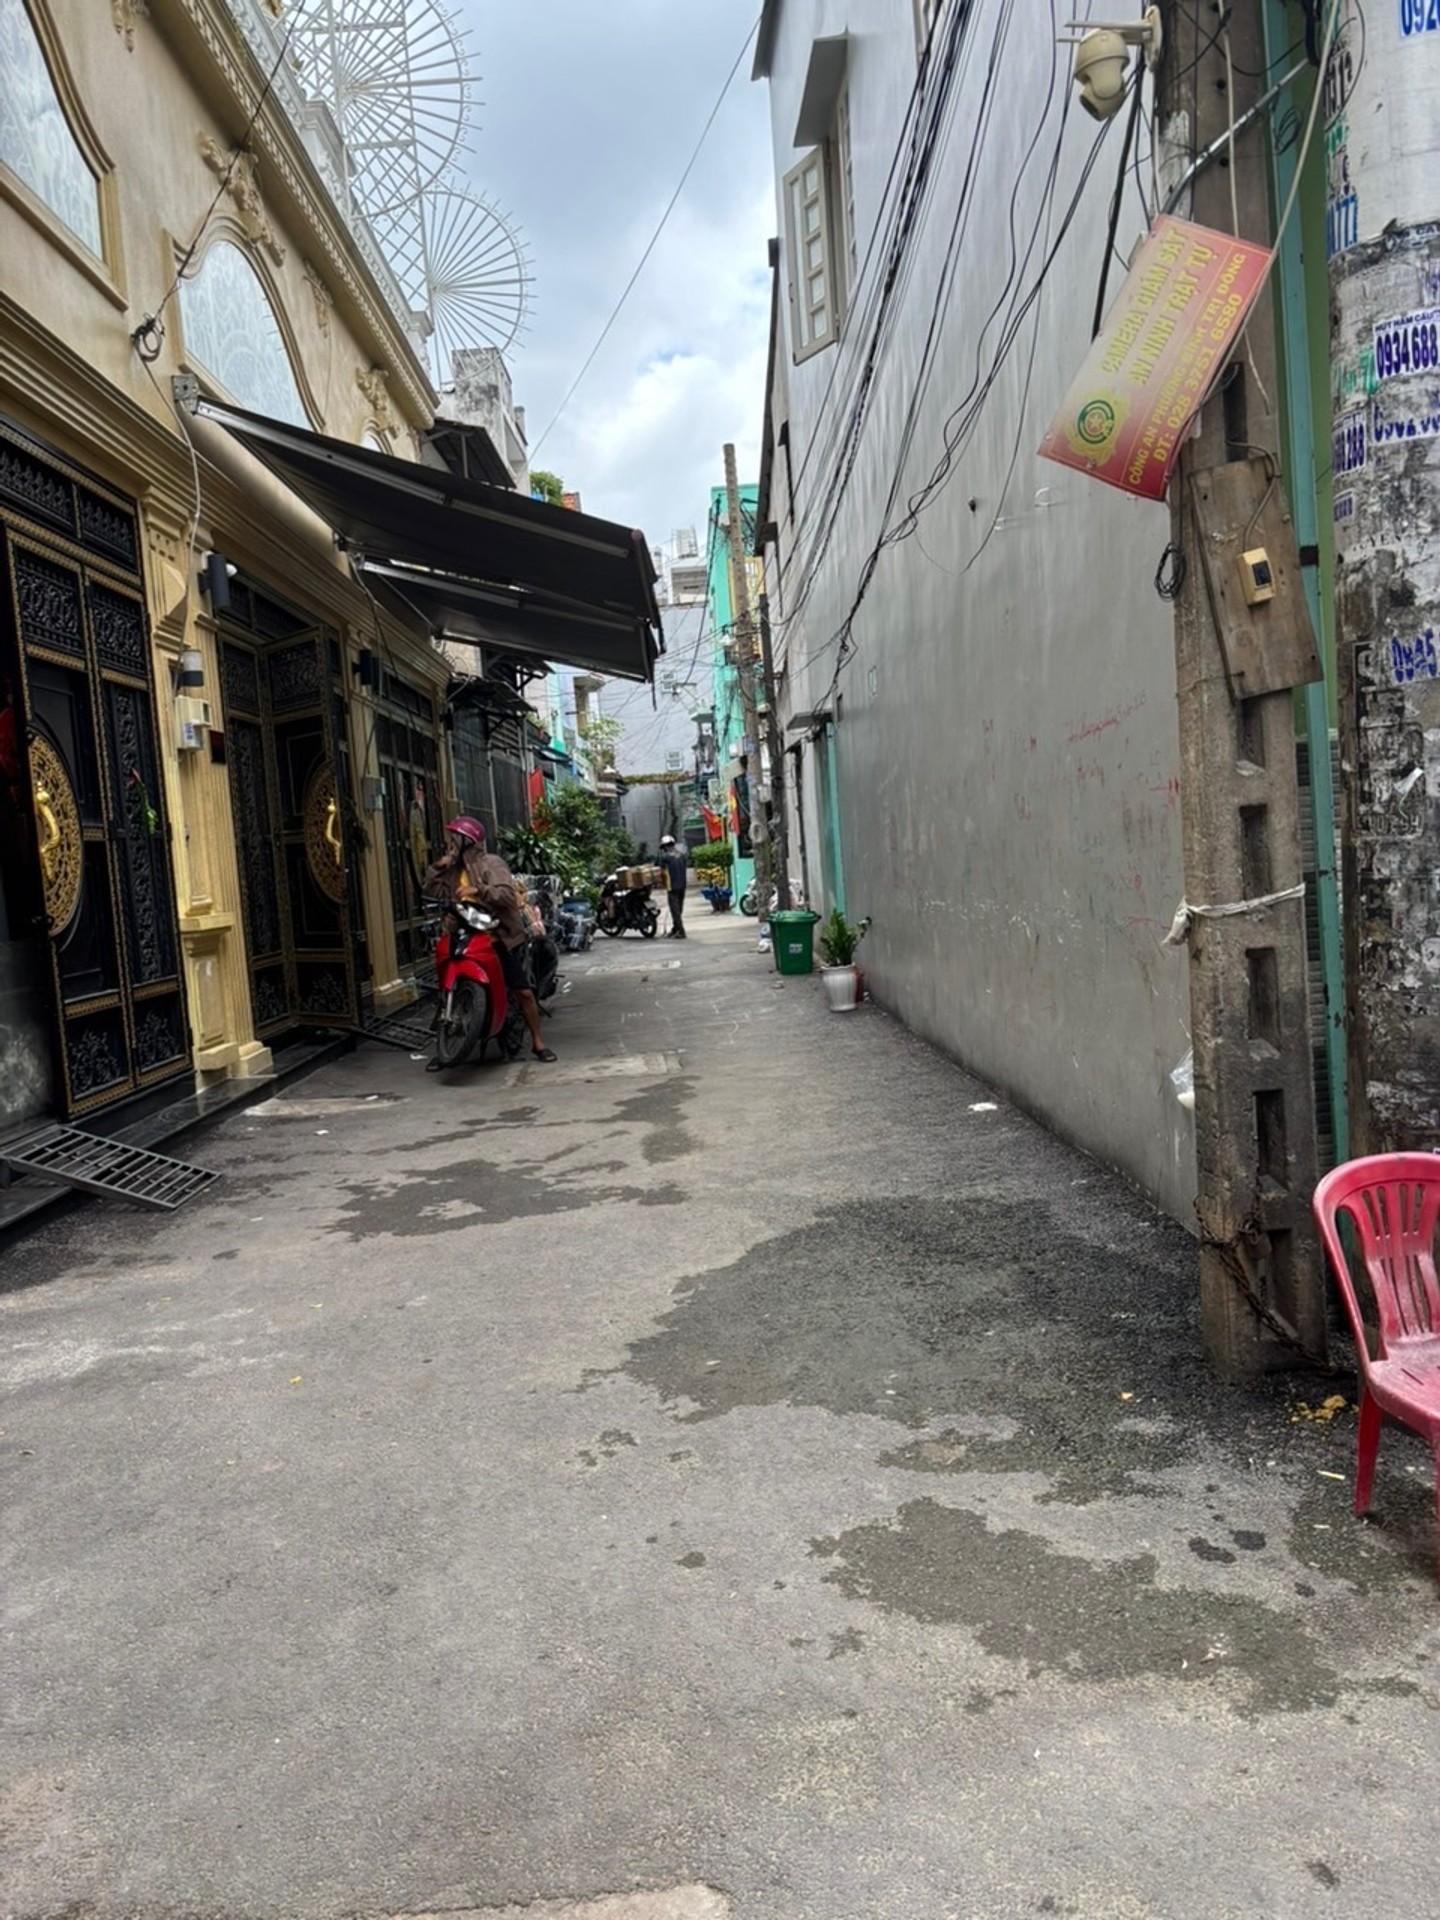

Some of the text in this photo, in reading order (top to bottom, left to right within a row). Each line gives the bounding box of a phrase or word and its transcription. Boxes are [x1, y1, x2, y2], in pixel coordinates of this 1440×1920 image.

[1101, 228, 1187, 374] CAMERA GIÁM SÁT
[1163, 270, 1200, 311] TRẬT
[1128, 358, 1154, 384] AN
[1129, 449, 1149, 484] CÔNG
[1143, 426, 1158, 447] AN
[1217, 253, 1245, 294] ĐÔNG
[1140, 314, 1176, 358] NINH
[1167, 394, 1191, 428] 028
[1211, 293, 1241, 340] 6580
